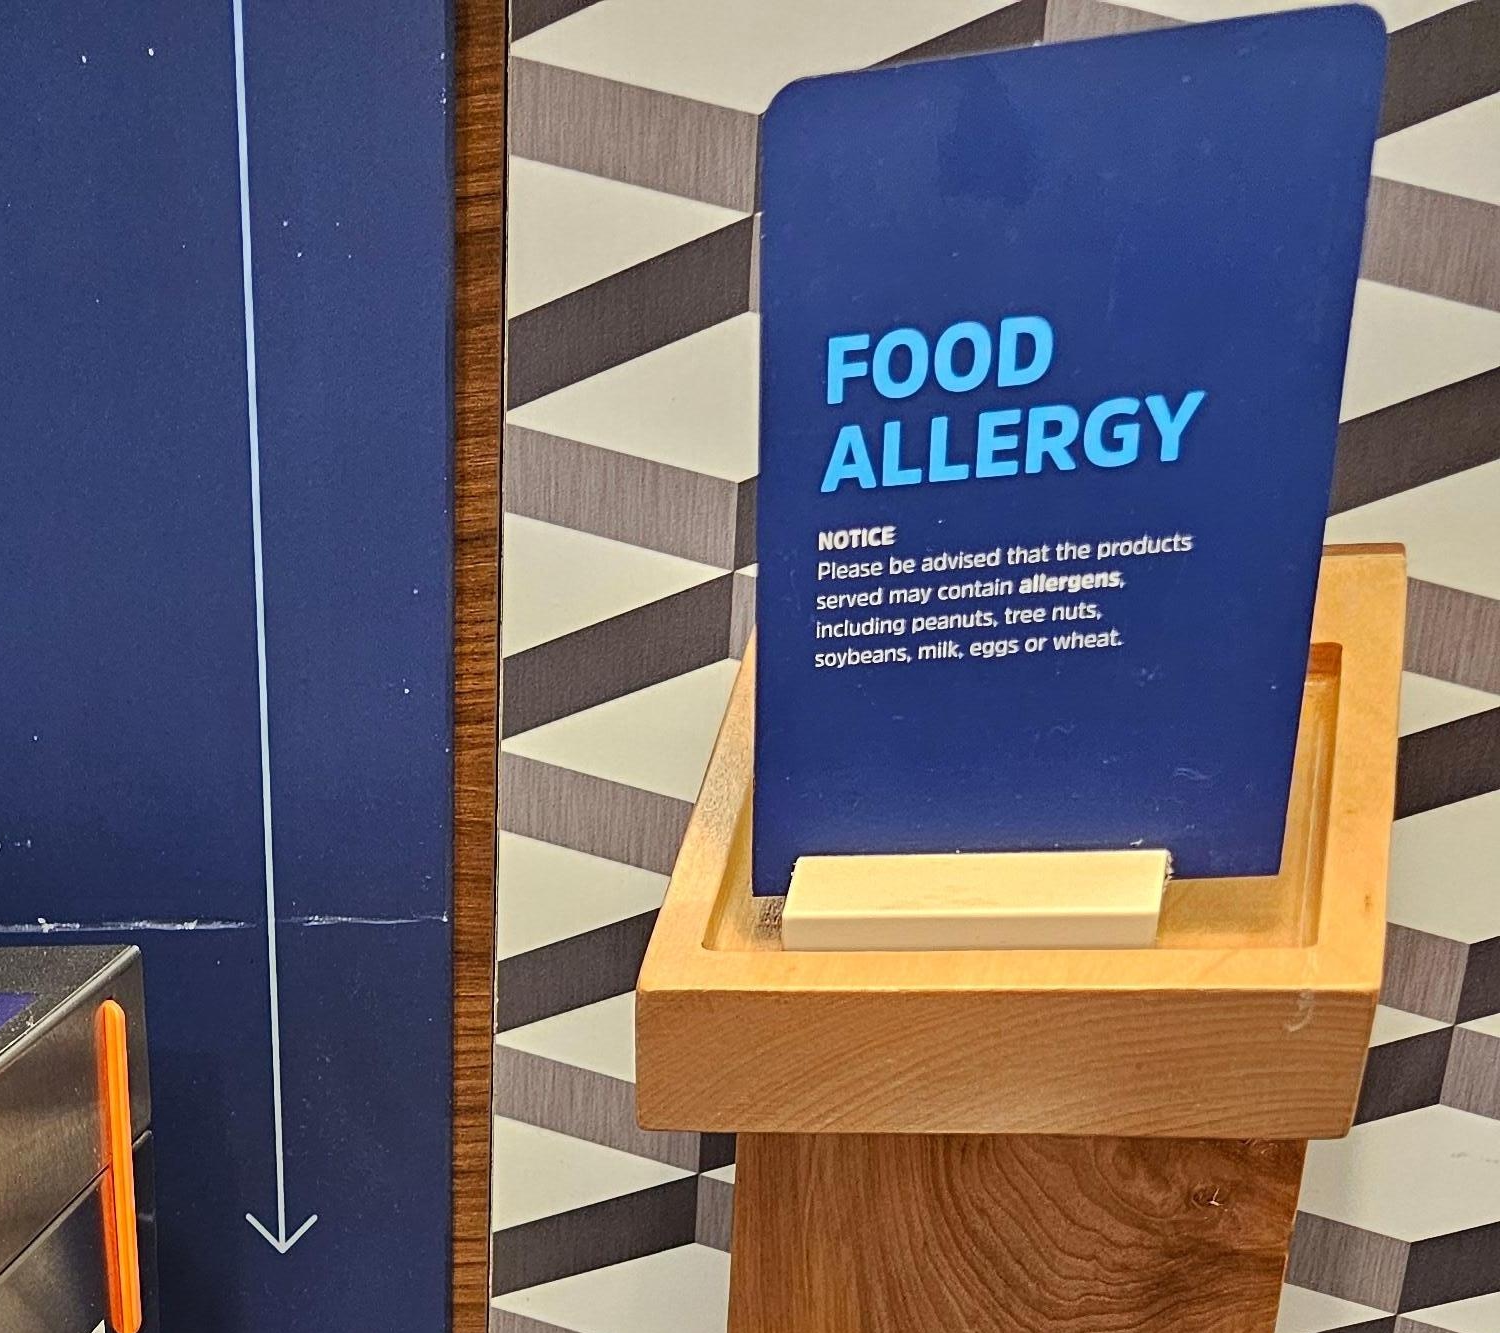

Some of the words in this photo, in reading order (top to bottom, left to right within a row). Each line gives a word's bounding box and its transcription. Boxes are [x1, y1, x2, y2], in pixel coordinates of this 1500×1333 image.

[826, 315, 1055, 405] FOOD
[820, 390, 1206, 493] ALLERGY
[817, 525, 897, 551] NOTICE
[817, 557, 883, 581] Please
[889, 555, 915, 576] be
[921, 548, 1001, 573] advised
[1006, 544, 1050, 566] that
[1056, 541, 1091, 561] the
[1097, 532, 1196, 560] products
[816, 586, 883, 611] served
[888, 584, 932, 606] may
[937, 576, 1014, 600] contain
[1018, 569, 1126, 597] allergens,
[815, 614, 906, 640] including
[911, 612, 999, 635] peanuts,
[1004, 607, 1047, 627] tree
[1051, 602, 1103, 624] nuts,
[815, 643, 913, 670] soybeans,
[917, 638, 965, 661] milk,
[969, 636, 1020, 659] eggs
[1024, 634, 1048, 653] or
[1052, 627, 1125, 652] wheat.
